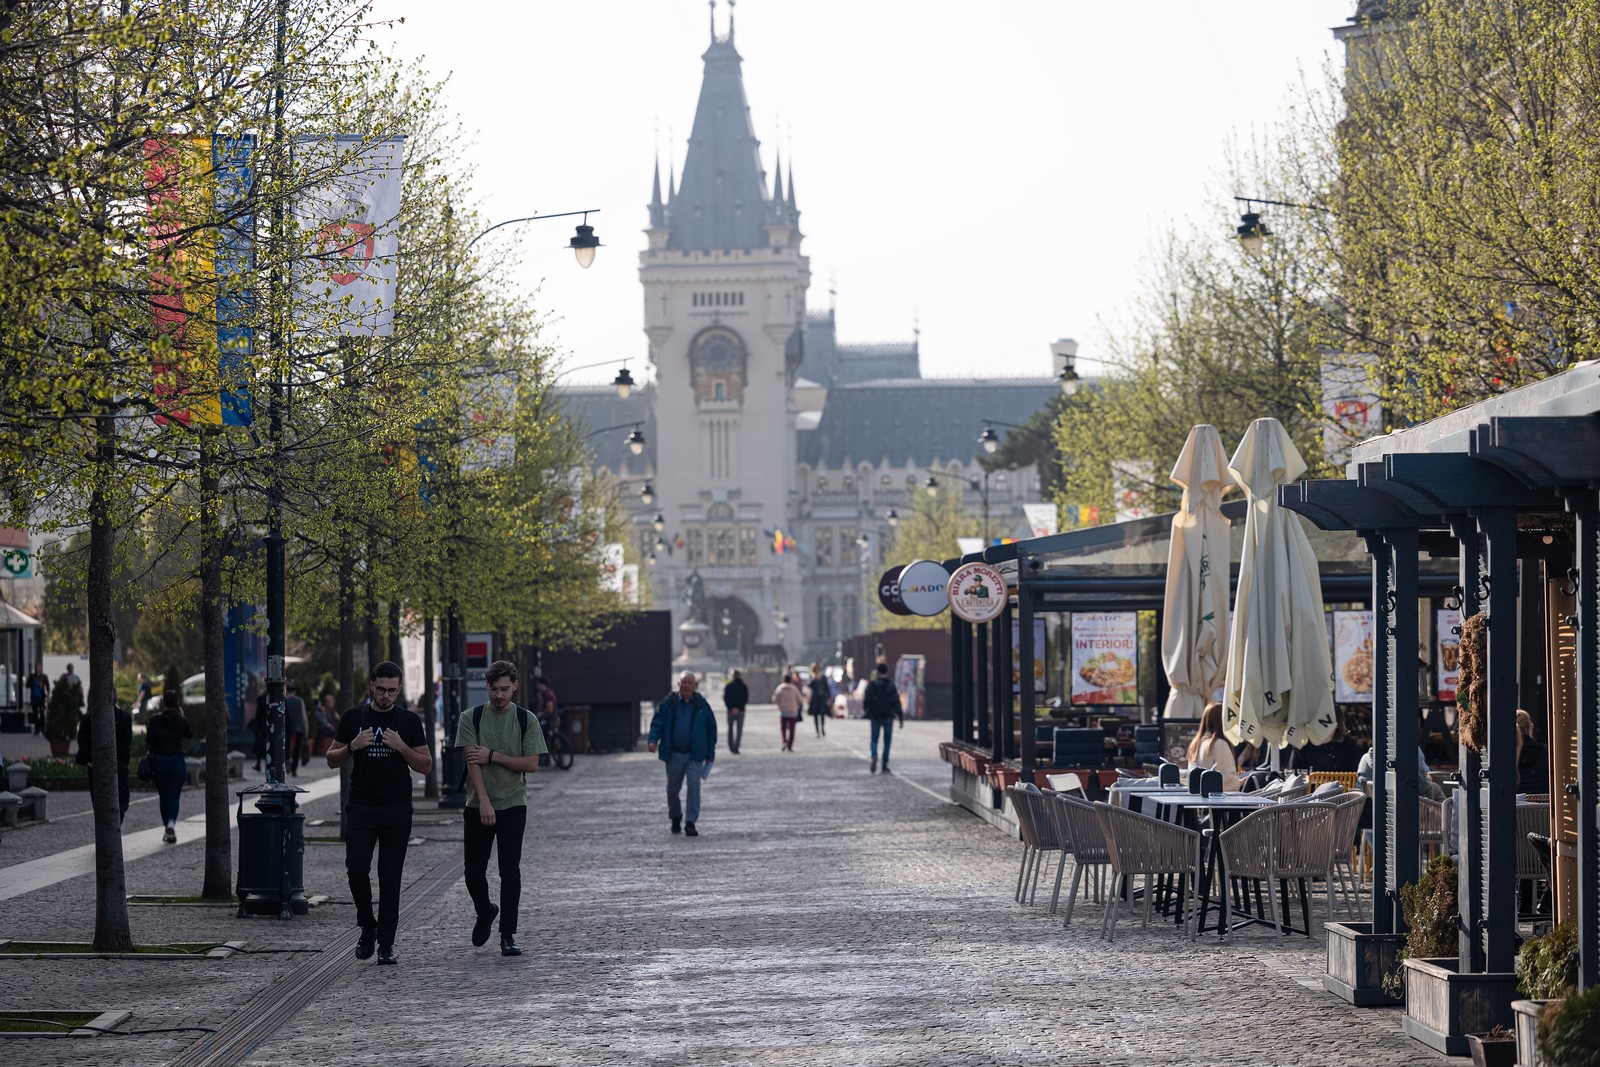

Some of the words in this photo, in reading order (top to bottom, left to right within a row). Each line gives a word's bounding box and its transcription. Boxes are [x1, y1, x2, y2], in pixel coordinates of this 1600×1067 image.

[952, 570, 972, 596] BIRRA
[973, 567, 1003, 596] MORETTI
[1075, 639, 1134, 650] INTERIOR!
